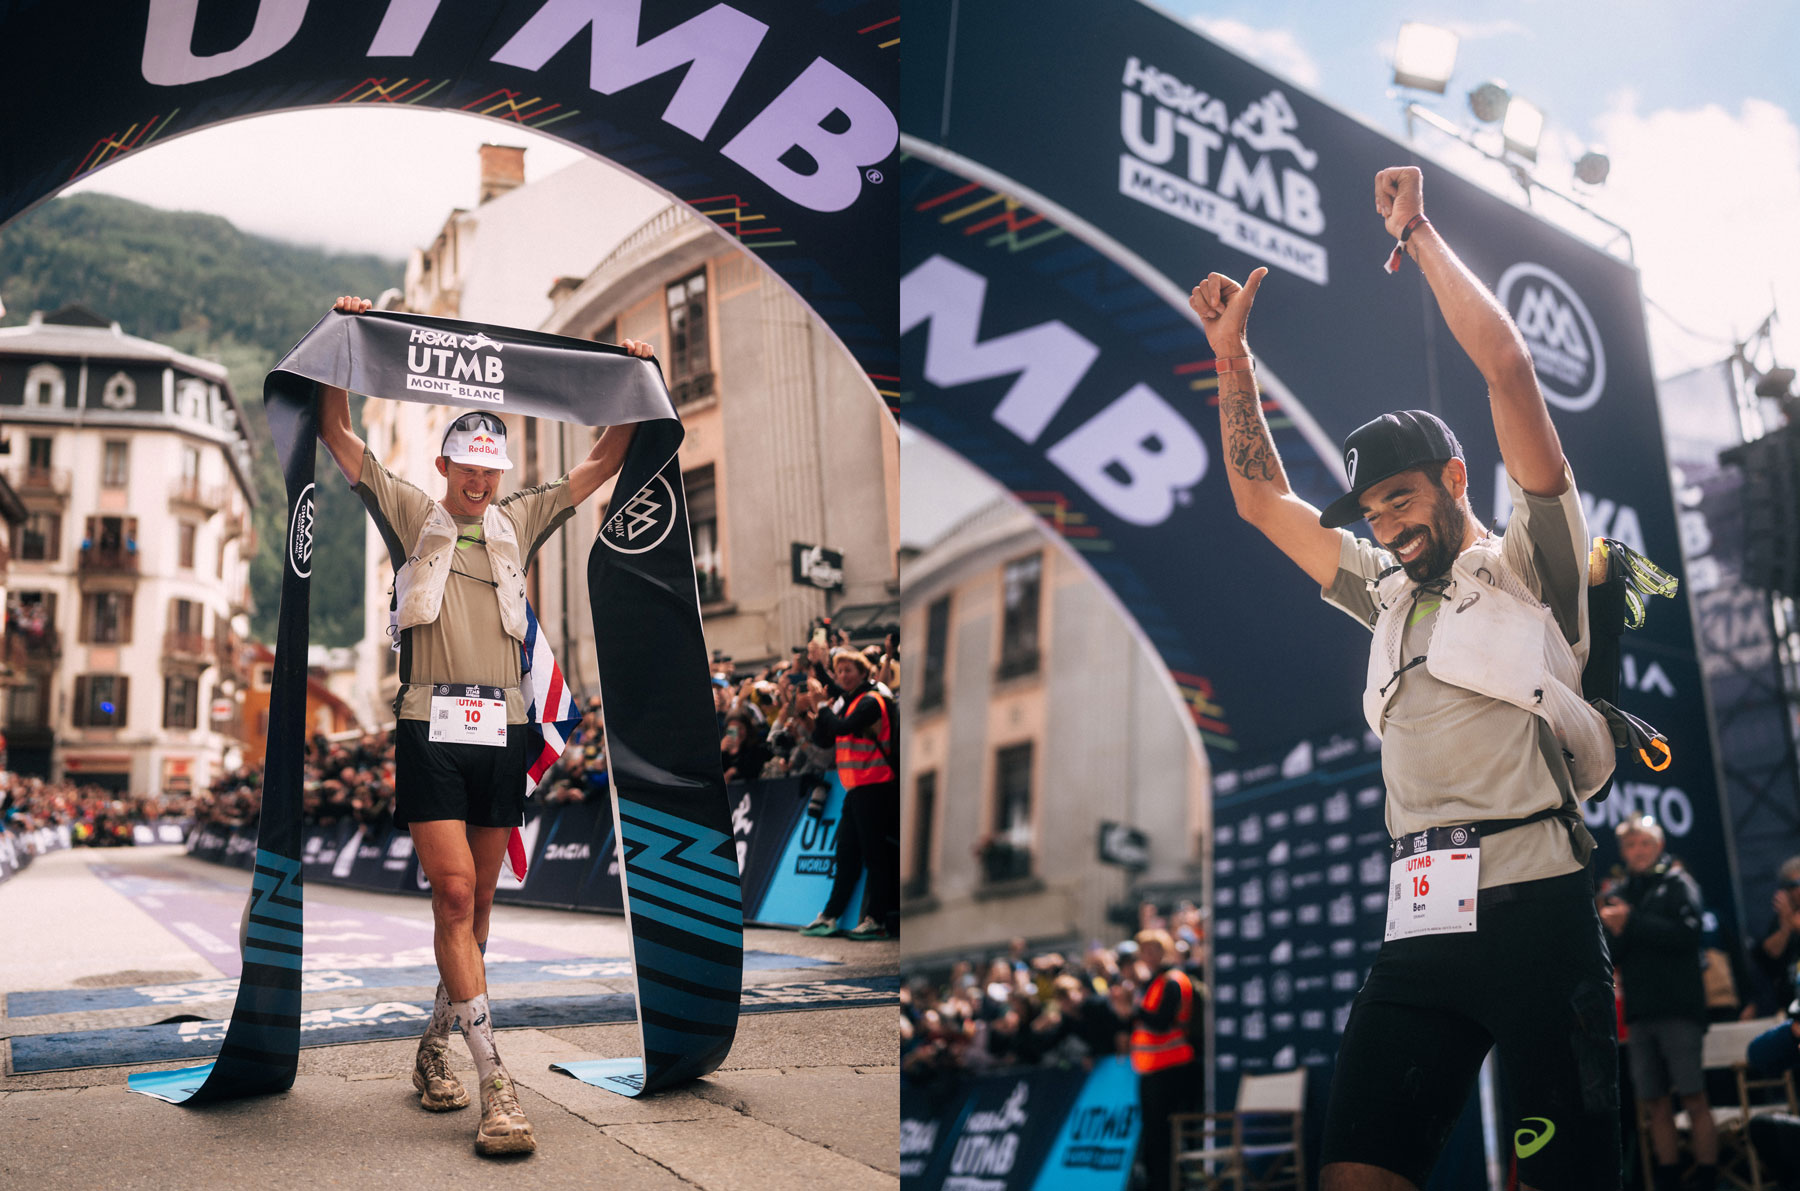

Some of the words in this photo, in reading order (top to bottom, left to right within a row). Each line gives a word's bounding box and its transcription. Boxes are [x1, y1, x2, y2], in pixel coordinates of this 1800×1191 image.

[1121, 56, 1229, 134] HOKA
[1120, 89, 1326, 236] UTMB
[409, 329, 459, 349] HOKA
[407, 345, 505, 384] UTMB
[468, 445, 485, 453] Red
[485, 446, 499, 456] Bull
[297, 505, 307, 560] CHAMONIX
[613, 511, 625, 538] ONIX
[458, 699, 483, 707] UTMB
[465, 710, 481, 723] 10
[1583, 780, 1694, 837] UNTO
[1407, 855, 1432, 872] UTMB
[1412, 874, 1430, 898] 16
[1413, 902, 1426, 912] Ben
